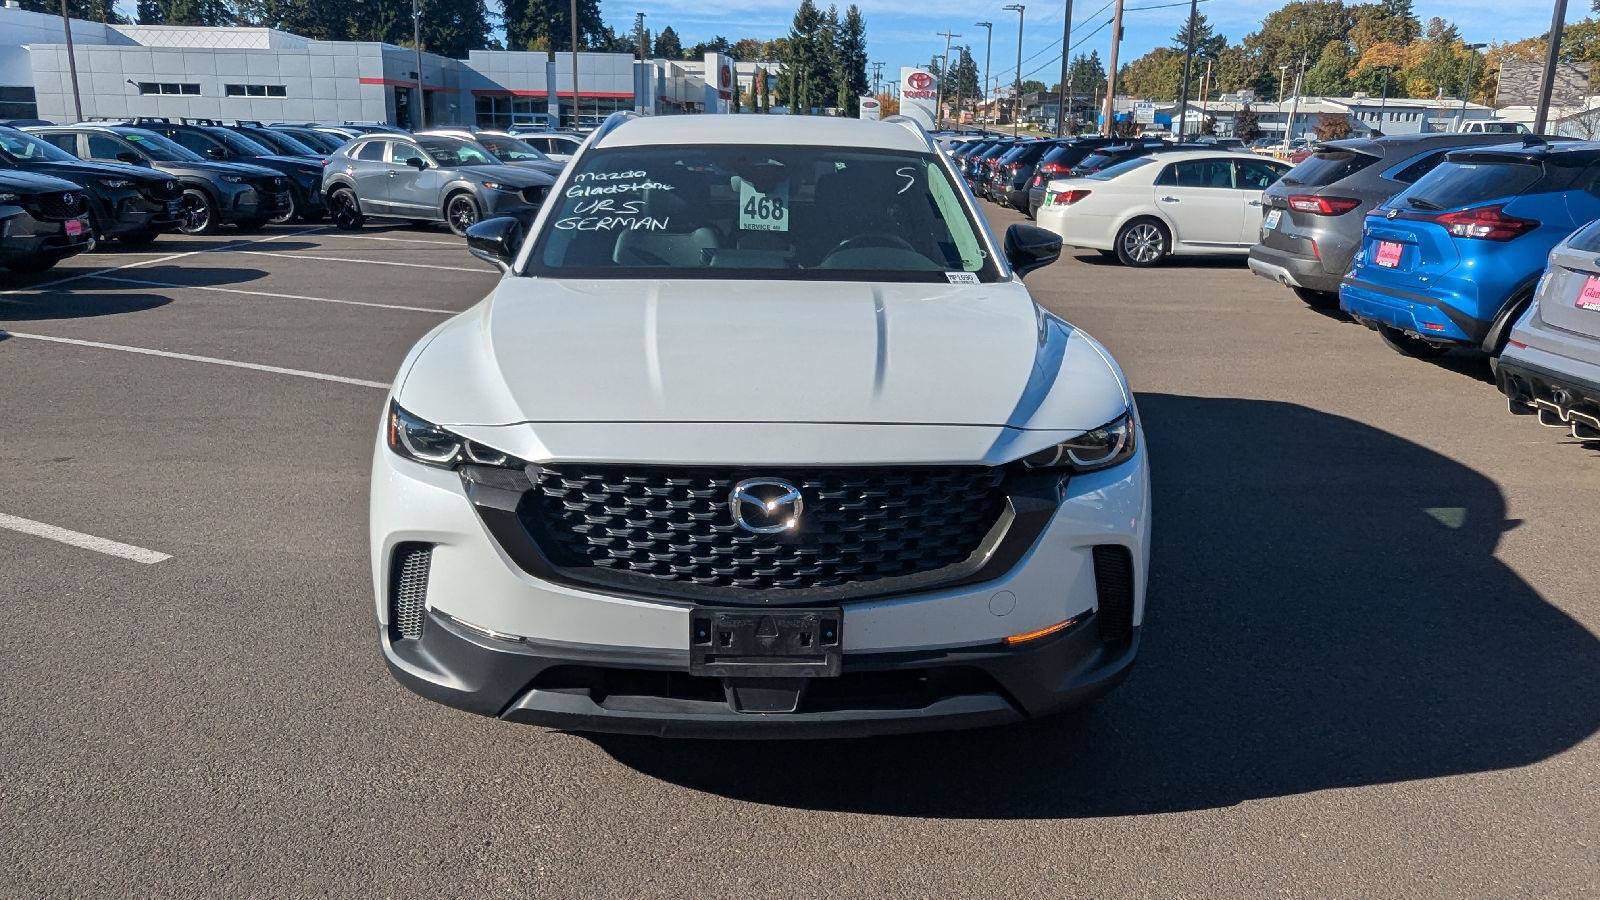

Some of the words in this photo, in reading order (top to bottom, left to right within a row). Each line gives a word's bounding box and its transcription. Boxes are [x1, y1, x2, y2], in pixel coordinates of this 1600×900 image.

[903, 90, 936, 99] TOYOTA
[566, 182, 675, 198] Gladstone
[743, 195, 784, 221] 468
[555, 217, 670, 231] GERMAN
[743, 223, 771, 231] SERVICE
